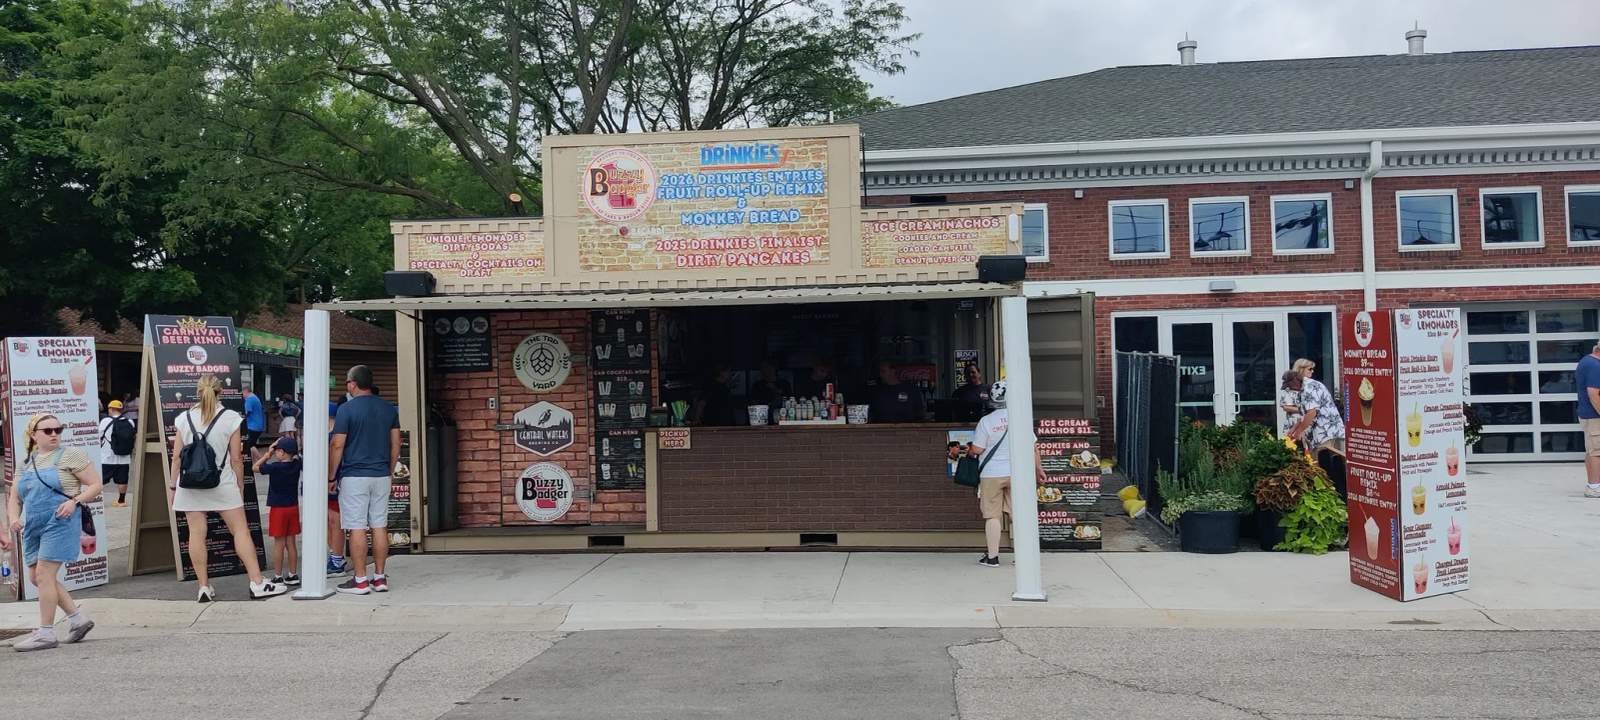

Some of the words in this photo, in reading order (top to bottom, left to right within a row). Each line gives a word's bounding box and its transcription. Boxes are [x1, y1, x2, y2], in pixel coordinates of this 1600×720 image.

[661, 174, 693, 187] 2026
[697, 171, 762, 186] DRINKIES
[767, 170, 824, 182] ENTRIES
[656, 186, 701, 199] FRUIT
[705, 184, 770, 198] ROLL-UP
[775, 182, 825, 195] REMIX
[737, 198, 747, 209] &
[681, 211, 745, 225] MONKEY
[750, 209, 800, 223] BREAD
[873, 222, 896, 232] ICE
[899, 220, 941, 231] CREAM
[945, 217, 1000, 229] NACHOS
[425, 235, 463, 243] UNIQUE
[466, 233, 526, 242] LEMONADES
[892, 234, 929, 242] COOKIES
[442, 243, 472, 251] DIRTY
[475, 243, 509, 251] SODAS
[656, 239, 687, 251] 2025
[692, 237, 756, 250] DRINKIES
[759, 236, 823, 248] FINALIST
[410, 260, 464, 269] SPECIALTY
[466, 259, 523, 268] COCKTAILS
[526, 259, 541, 267] ON
[676, 254, 723, 267] DIRTY
[727, 251, 811, 266] PANCAKES
[959, 255, 977, 263] CUP
[460, 268, 492, 277] DRAFT
[1417, 309, 1455, 320] SPECIALTY
[1417, 320, 1458, 330] LEMONADES
[162, 327, 223, 336] CARNIVAL
[37, 339, 88, 348] SPECIALTY
[162, 335, 191, 344] BEER
[526, 335, 542, 347] THE
[543, 335, 559, 345] TAP
[36, 348, 92, 358] LEMONADES
[1344, 349, 1366, 358] MONKEY
[1367, 350, 1387, 359] BREAD
[167, 364, 195, 373] BUZZY
[196, 364, 231, 373] BADGER
[532, 380, 556, 391] YARD
[1040, 419, 1056, 427] ICE
[1058, 419, 1089, 427] CREAM
[519, 430, 544, 440] CENTRAL
[546, 429, 569, 440] WATERS
[660, 430, 690, 438] PICKUP
[664, 440, 685, 448] HERE
[1070, 475, 1100, 483] BUTTER
[1365, 470, 1392, 482] ROLL-UP
[1360, 477, 1378, 489] REMIX
